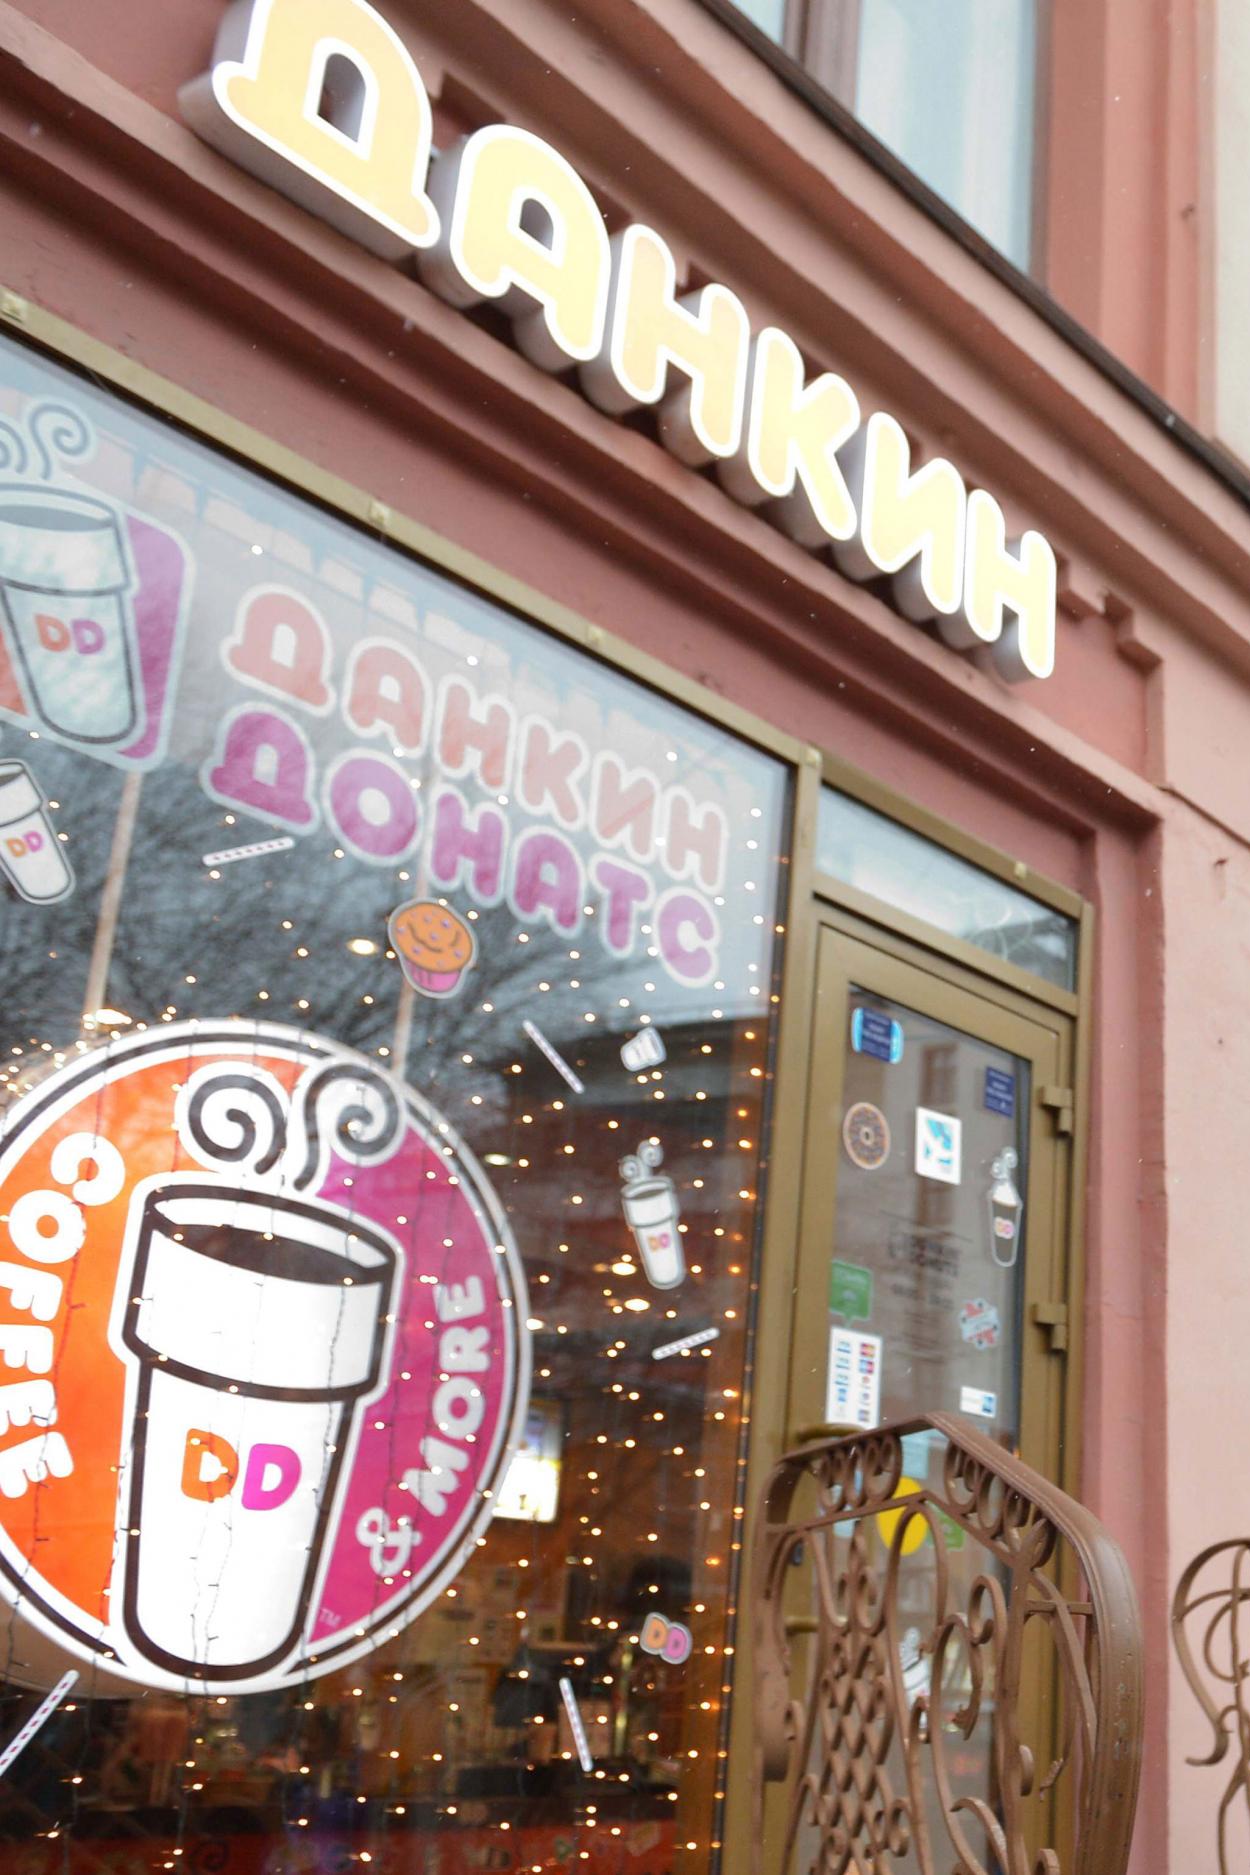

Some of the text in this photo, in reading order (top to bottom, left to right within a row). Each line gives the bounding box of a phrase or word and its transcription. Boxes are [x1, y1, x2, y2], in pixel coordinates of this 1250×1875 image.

[211, 0, 1057, 679] ДАНКИН
[34, 614, 105, 655] DD
[223, 587, 726, 889] ДАНКИН
[6, 831, 44, 858] DD
[207, 708, 717, 981] ДОНАТС
[0, 1132, 126, 1499] COFFEE
[356, 1274, 491, 1576] & MORE
[180, 1427, 300, 1511] DD
[644, 1616, 688, 1660] DD
